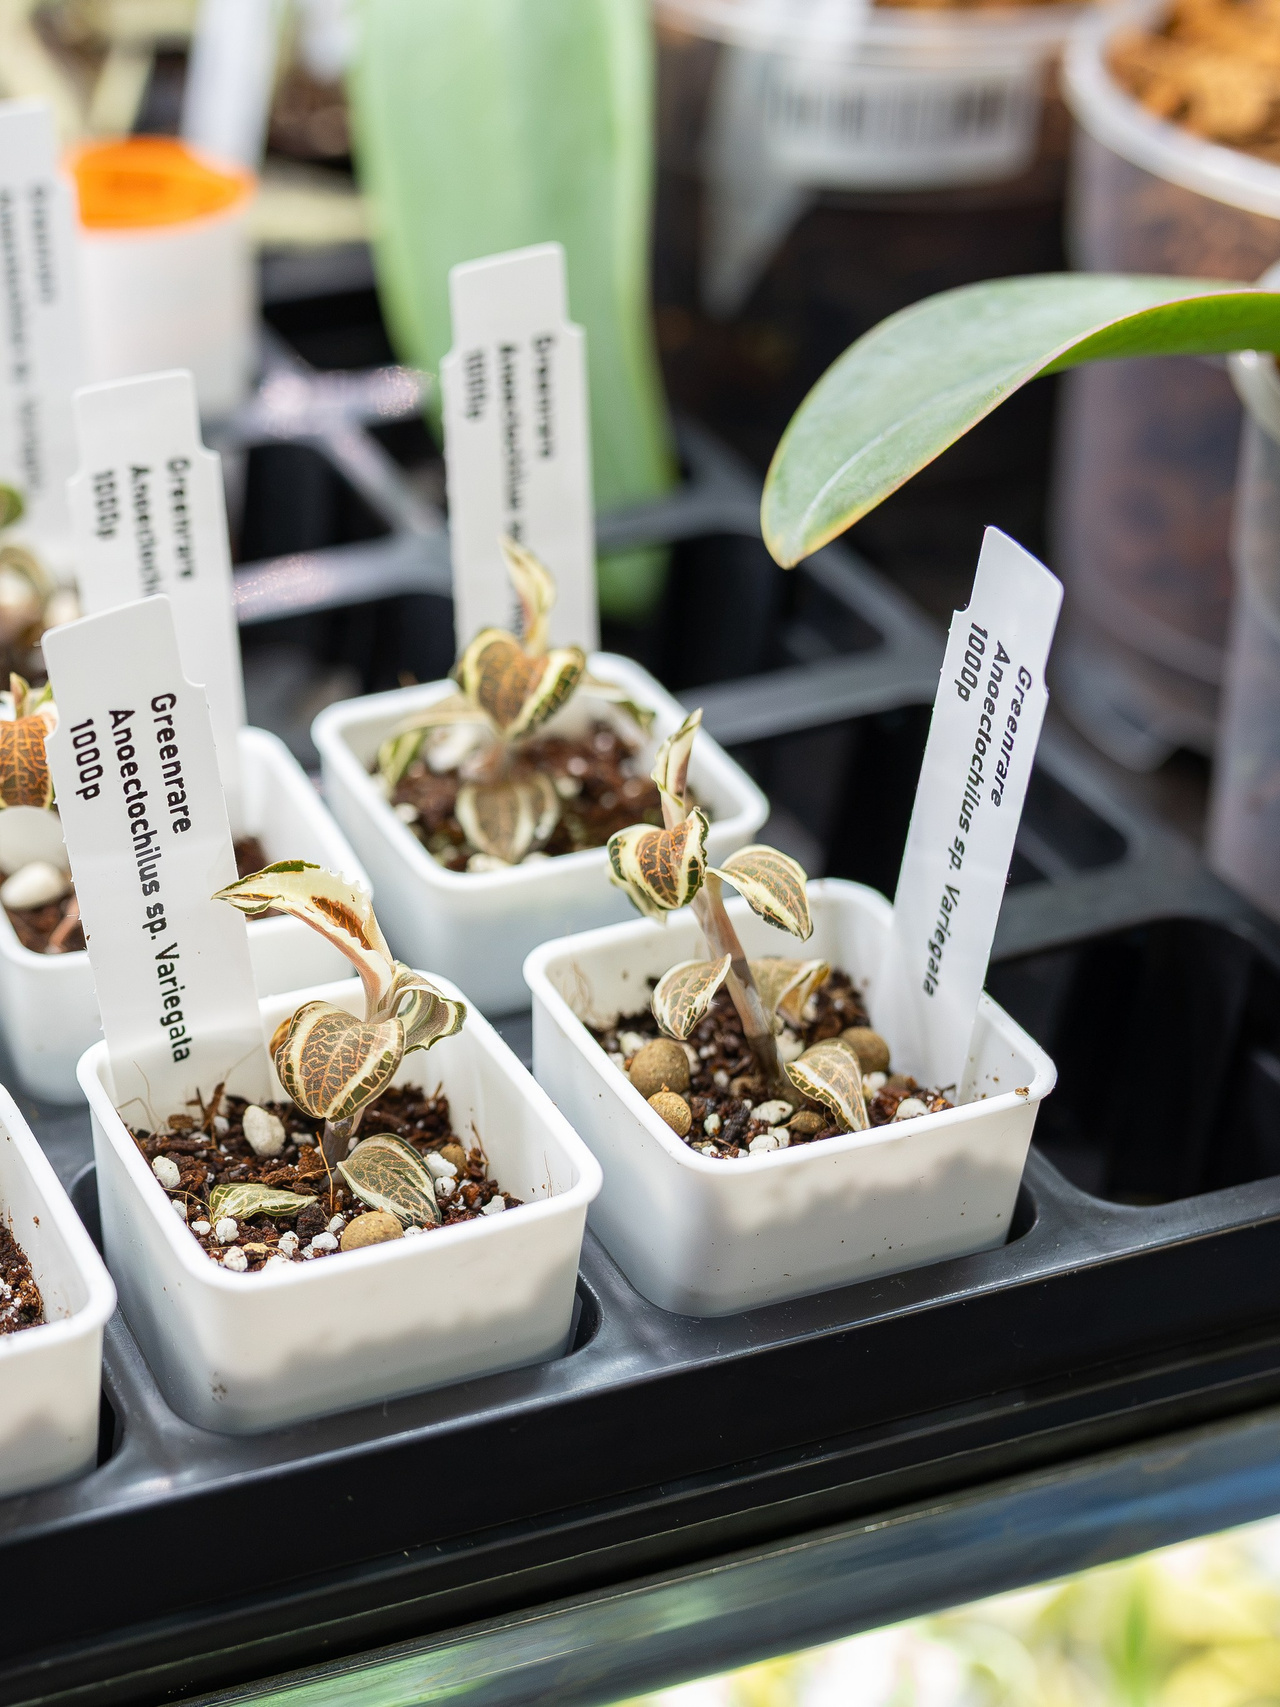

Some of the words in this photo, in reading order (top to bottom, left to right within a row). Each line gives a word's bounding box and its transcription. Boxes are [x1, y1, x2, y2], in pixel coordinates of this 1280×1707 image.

[956, 621, 988, 702] 1000p
[70, 718, 104, 801] 1000p
[151, 693, 192, 835] Greenrare
[958, 640, 1011, 832] Anoectochilus
[991, 664, 1032, 808] Greenrare
[108, 709, 162, 896] Anoectochilus
[142, 902, 165, 940] sp.
[155, 942, 192, 1063] Variegata
[948, 836, 967, 872] sp.
[923, 881, 961, 998] Variegata
